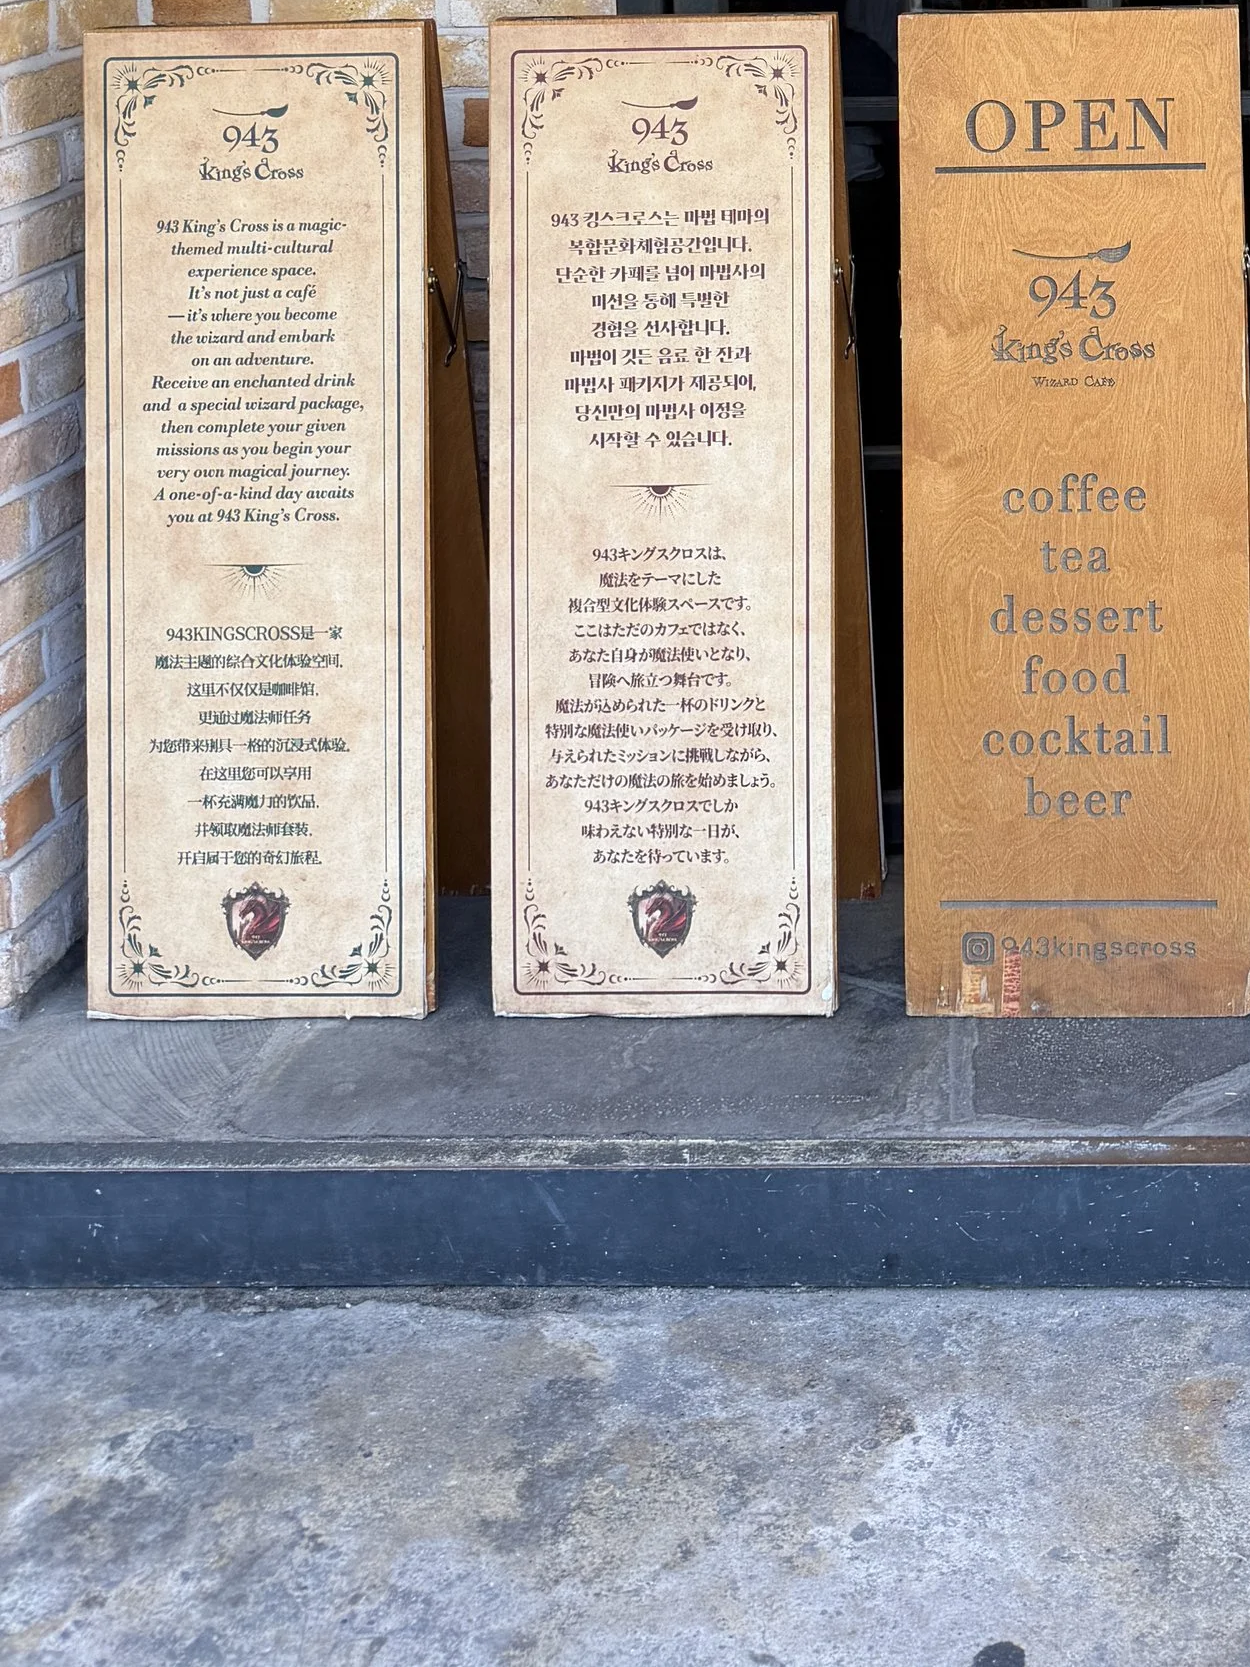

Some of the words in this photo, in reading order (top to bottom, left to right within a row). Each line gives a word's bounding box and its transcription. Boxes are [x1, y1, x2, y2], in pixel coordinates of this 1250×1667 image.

[631, 113, 689, 146] 943
[965, 97, 1175, 153] OPEN
[222, 121, 279, 154] 943
[198, 156, 252, 183] King's
[253, 156, 305, 181] Cross
[607, 148, 661, 175] King's
[663, 149, 714, 173] Cross
[155, 219, 180, 235] 943
[181, 218, 227, 238] King's
[229, 217, 270, 233] Cross
[271, 218, 284, 233] is
[285, 222, 296, 232] a
[298, 217, 347, 236] magic-
[550, 212, 580, 228] 943
[582, 210, 680, 229] 킹스크로스는
[683, 208, 716, 227] 마법
[720, 207, 770, 226] 테마의
[171, 239, 225, 256] themed
[226, 237, 335, 255] multi-cultural
[567, 235, 753, 256] 복합문화체험공간입니다.
[187, 263, 269, 283] experience
[270, 266, 317, 282] space.
[555, 265, 607, 285] 단순한
[609, 264, 662, 283] 카페를
[664, 263, 695, 283] 넘어
[699, 262, 766, 282] 마법사의
[187, 285, 212, 300] It's
[214, 287, 240, 300] not
[238, 285, 271, 304] just
[272, 289, 283, 299] a
[285, 283, 317, 304] café
[591, 292, 640, 311] 미션을
[641, 291, 677, 311] 통해
[679, 290, 731, 309] 특별한
[1028, 269, 1117, 319] 943
[210, 306, 253, 323] where
[253, 311, 282, 327] you
[283, 306, 338, 322] become
[170, 329, 194, 345] the
[194, 329, 245, 345] wizard
[246, 328, 277, 344] and
[278, 328, 336, 344] embark
[590, 319, 640, 339] 경험을
[642, 318, 731, 338] 선사합니다.
[991, 324, 1073, 364] King's
[1078, 325, 1156, 362] Cross
[190, 357, 211, 367] on
[212, 356, 233, 367] an
[234, 351, 315, 367] adventure.
[569, 348, 617, 367] 마법이
[620, 347, 653, 367] 깃든
[656, 346, 691, 366] 음료
[693, 345, 713, 365] 한
[715, 345, 753, 364] 잔과
[150, 375, 209, 390] Receive
[210, 379, 231, 389] an
[233, 372, 312, 389] enchanted
[313, 372, 356, 388] drink
[564, 376, 616, 395] 마법사
[618, 374, 686, 394] 패키지가
[688, 373, 757, 393] 제공되어,
[142, 396, 172, 412] and
[177, 401, 188, 412] a
[189, 396, 243, 416] special
[244, 395, 298, 414] wizard
[296, 394, 365, 415] package,
[574, 403, 641, 422] 당신만의
[644, 402, 696, 421] 마법사
[160, 419, 194, 434] then
[196, 418, 266, 438] complete
[266, 422, 304, 438] your
[302, 417, 347, 438] given
[588, 430, 642, 450] 시작할
[643, 431, 662, 449] 수
[665, 429, 733, 449] 있습니다.
[155, 441, 220, 457] missions
[221, 446, 239, 456] as
[240, 445, 270, 461] you
[272, 440, 314, 460] begin
[314, 444, 353, 460] your
[156, 468, 191, 484] very
[192, 468, 226, 479] own
[228, 462, 289, 483] magical
[287, 463, 351, 483] journey.
[152, 486, 166, 502] A
[168, 484, 274, 505] one-of-a-kind
[274, 484, 304, 505] day
[305, 485, 355, 500] awaits
[1003, 473, 1147, 515] coffee
[165, 513, 195, 528] you
[197, 511, 214, 523] at
[216, 507, 242, 523] 943
[242, 507, 291, 528] King's
[294, 506, 340, 523] Cross.
[591, 545, 727, 563] 943キングスクロスは、
[1040, 539, 1110, 576] tea
[598, 570, 722, 589] 魔法をテーマにした
[567, 595, 752, 614] 複合型文化体験スペースです。
[989, 595, 1164, 636] dessert
[165, 624, 344, 642] 943KINGSCROSS是一家
[574, 620, 746, 638] ここはただのカフェではなく、
[568, 645, 751, 664] あなた自身が魔法使いとなり、
[588, 670, 732, 690] 冒険へ旅立つ舞台です。
[1021, 653, 1131, 697] food
[554, 696, 766, 715] 魔法が込められた一杯のドリンクと
[197, 708, 312, 726] 更通过魔法师任务
[544, 721, 778, 740] 特別な魔法使いパッケージを受け取り、
[981, 713, 1172, 757] cocktail
[549, 746, 771, 765] 与えられたミッションに挑戦しながら、
[198, 764, 313, 782] 在这里您可以享用
[545, 772, 776, 790] あなただけの魔法の旅を始めましょう。
[583, 797, 739, 815] 943キングスクロスでしか
[1024, 777, 1132, 819] beer
[581, 822, 740, 840] 味わえない特別な一日が、
[592, 847, 730, 865] あなたを待っています。
[1001, 935, 1197, 966] 943kingscross
